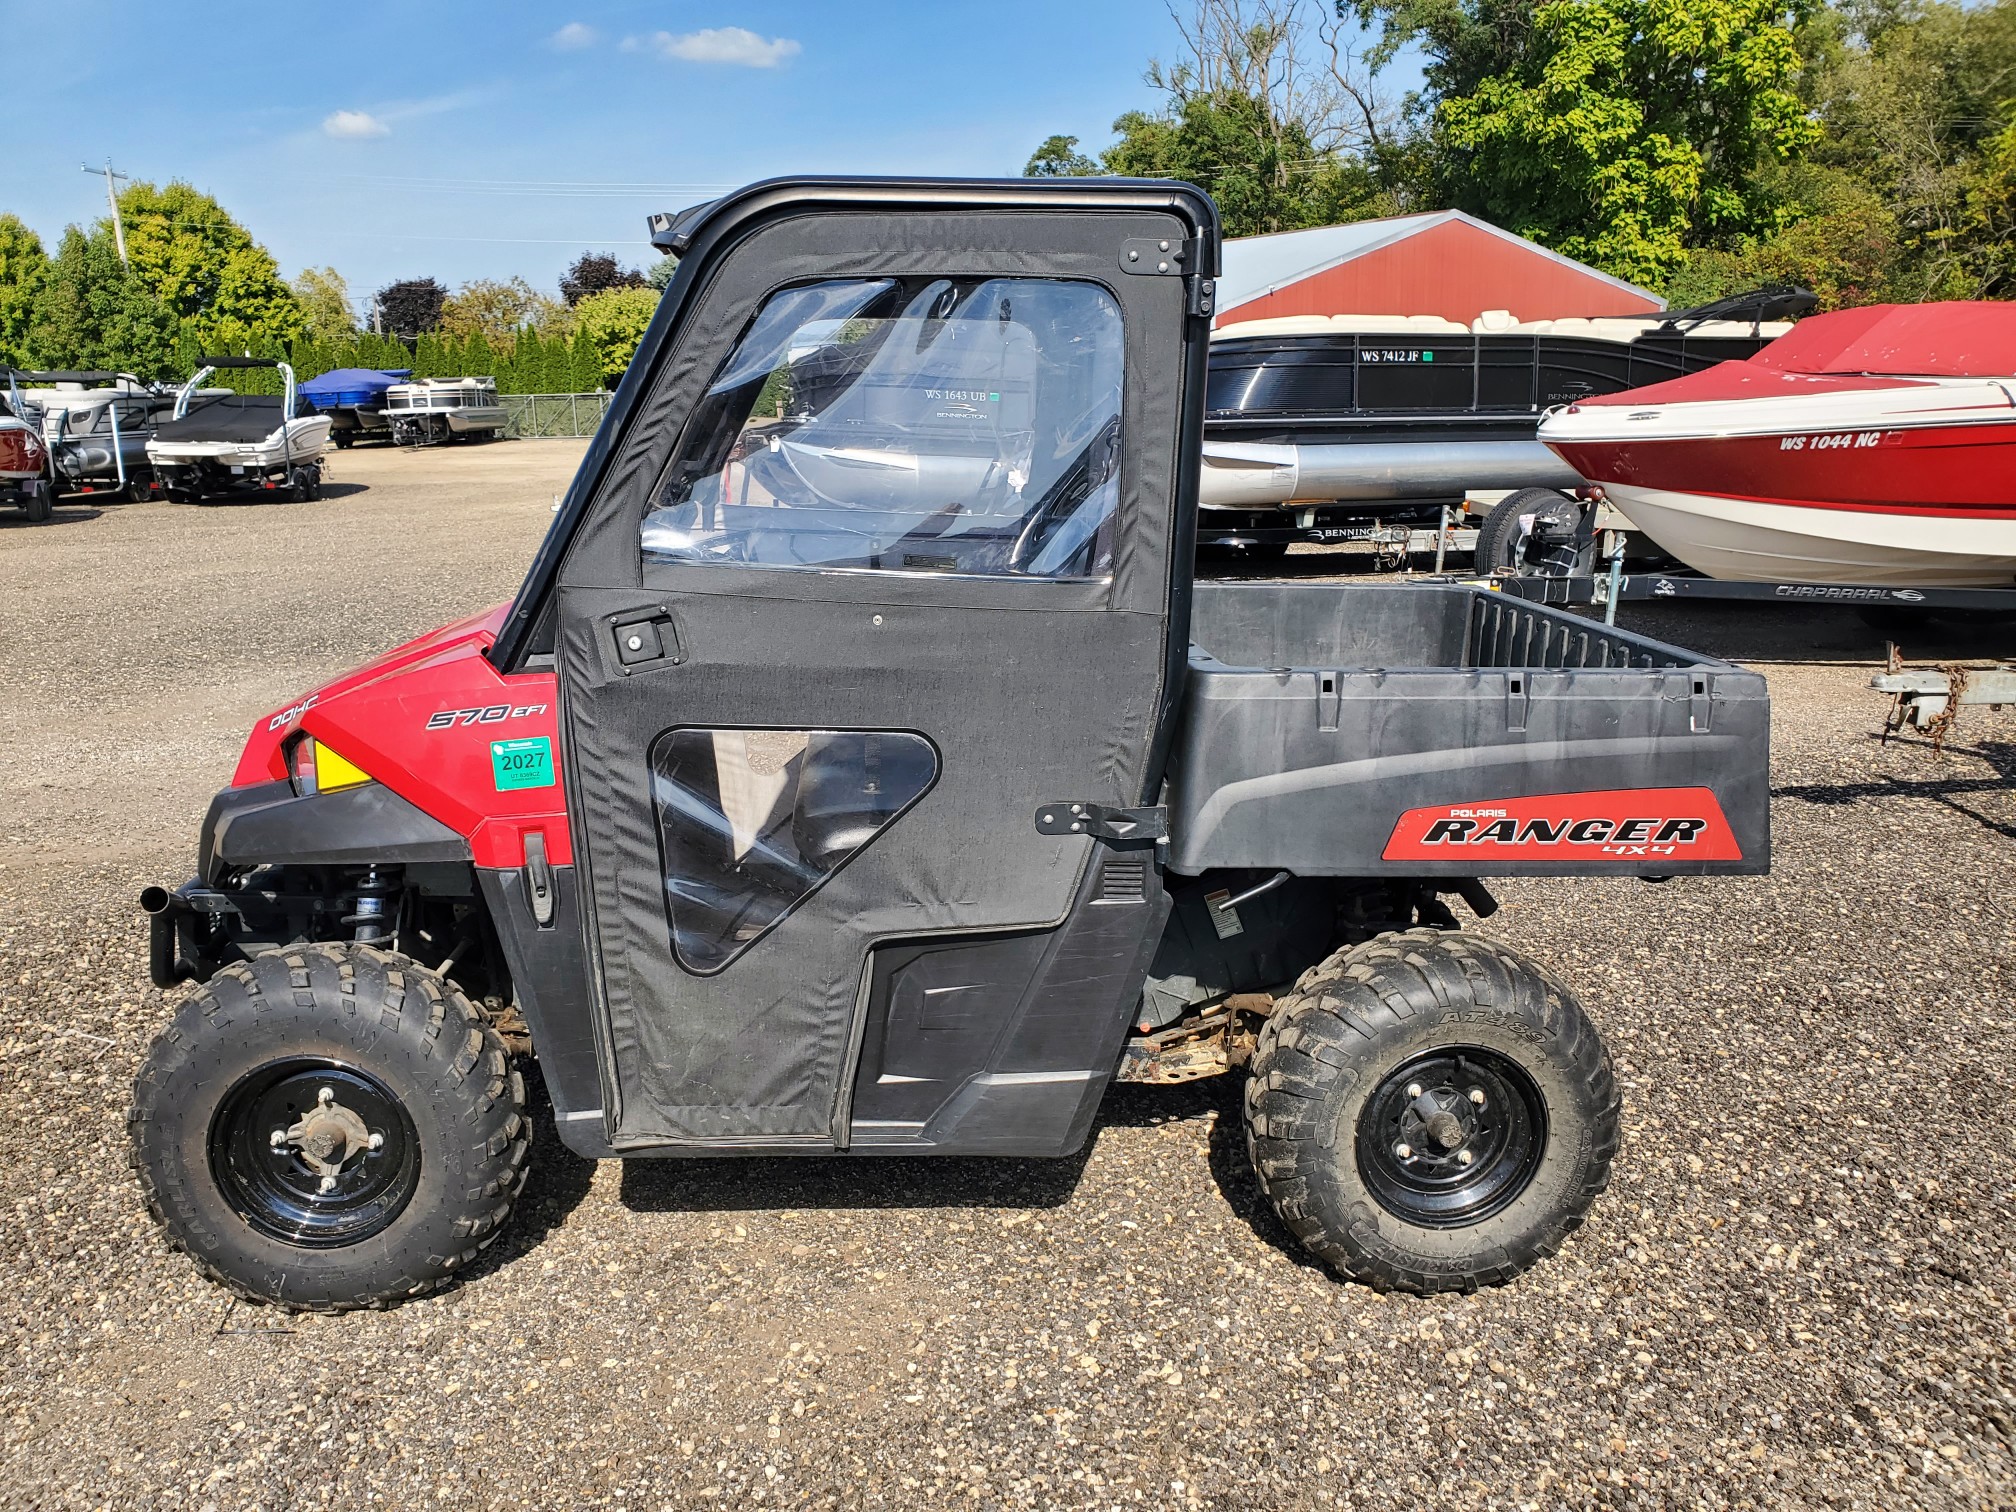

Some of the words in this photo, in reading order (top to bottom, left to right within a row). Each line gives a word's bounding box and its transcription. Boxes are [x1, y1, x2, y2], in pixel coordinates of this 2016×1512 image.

[1361, 350, 1380, 362] WS
[1381, 350, 1406, 362] 7412
[1407, 350, 1420, 362] JF
[925, 389, 942, 400] WS
[944, 390, 967, 400] 1643
[969, 391, 986, 402] UB
[936, 412, 988, 420] BENNINGTON
[1780, 436, 1807, 451] WS
[1809, 434, 1853, 450] 1044
[1853, 431, 1881, 448] NC
[1324, 528, 1375, 538] BENNING
[1775, 585, 1891, 600] CHAPARRAL
[268, 694, 319, 732] DOHC
[425, 704, 512, 731] 570
[511, 704, 548, 718] EFI
[501, 752, 545, 771] 2027
[1450, 808, 1507, 818] POLARIS
[1419, 817, 1710, 845] RANGER
